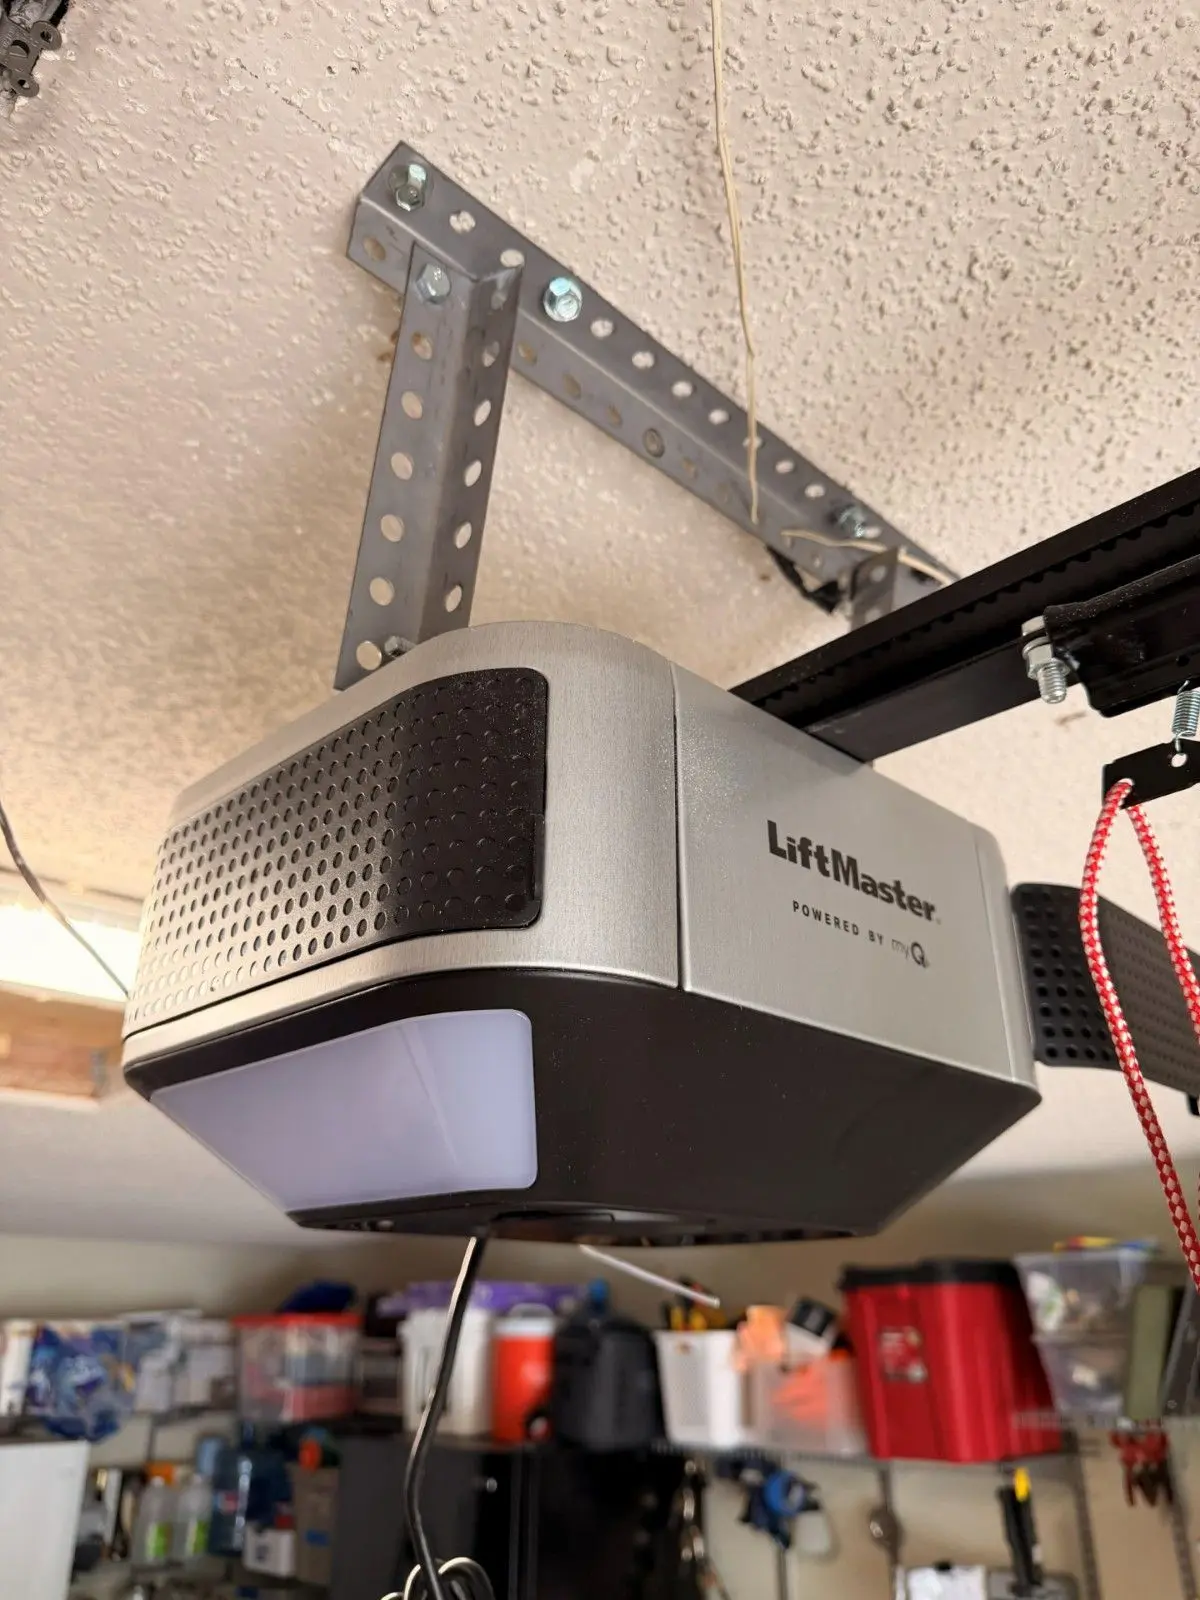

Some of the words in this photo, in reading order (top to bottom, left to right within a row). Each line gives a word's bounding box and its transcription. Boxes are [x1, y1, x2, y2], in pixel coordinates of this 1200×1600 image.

[767, 819, 936, 922] LiftMaster
[793, 900, 860, 936] POWERED
[868, 929, 884, 946] BY
[891, 939, 929, 968] myQ
